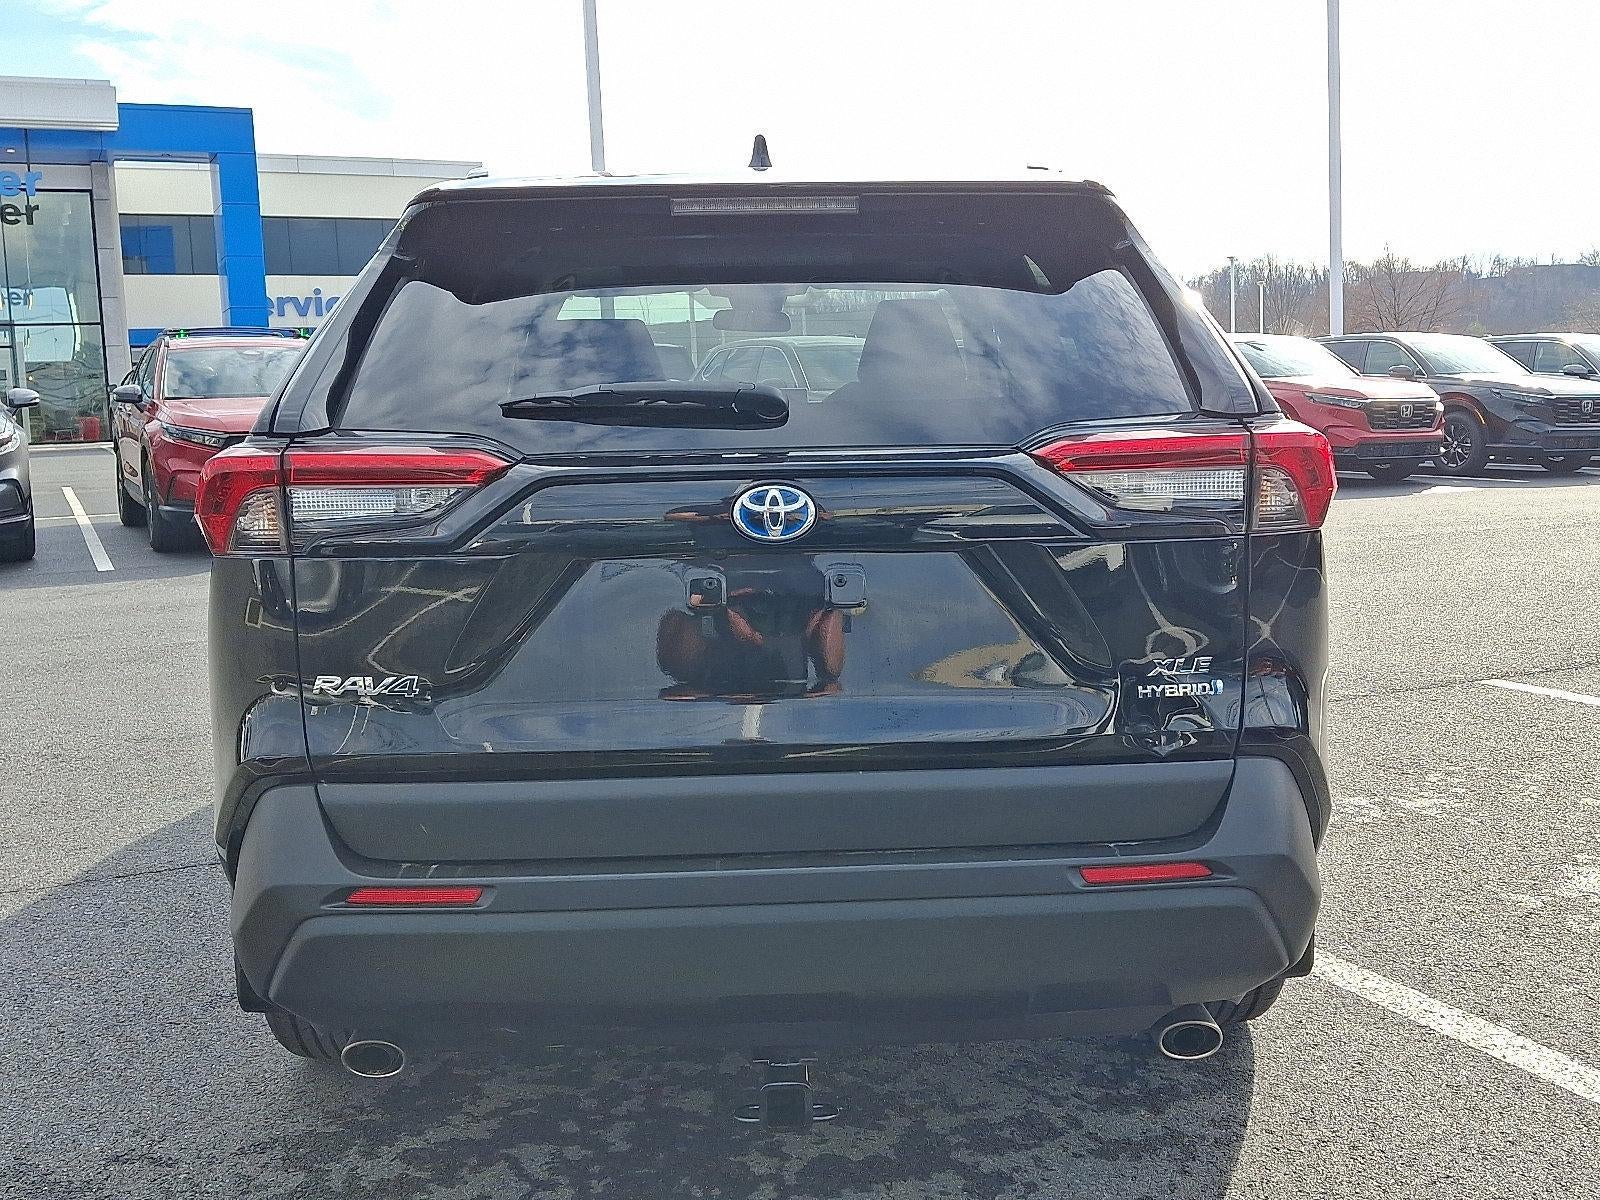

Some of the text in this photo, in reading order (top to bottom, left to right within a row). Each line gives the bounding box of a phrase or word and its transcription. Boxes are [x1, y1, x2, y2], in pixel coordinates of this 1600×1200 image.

[1147, 657, 1213, 676] XLE
[313, 676, 419, 697] RAV4
[1138, 683, 1211, 698] HYBRID
